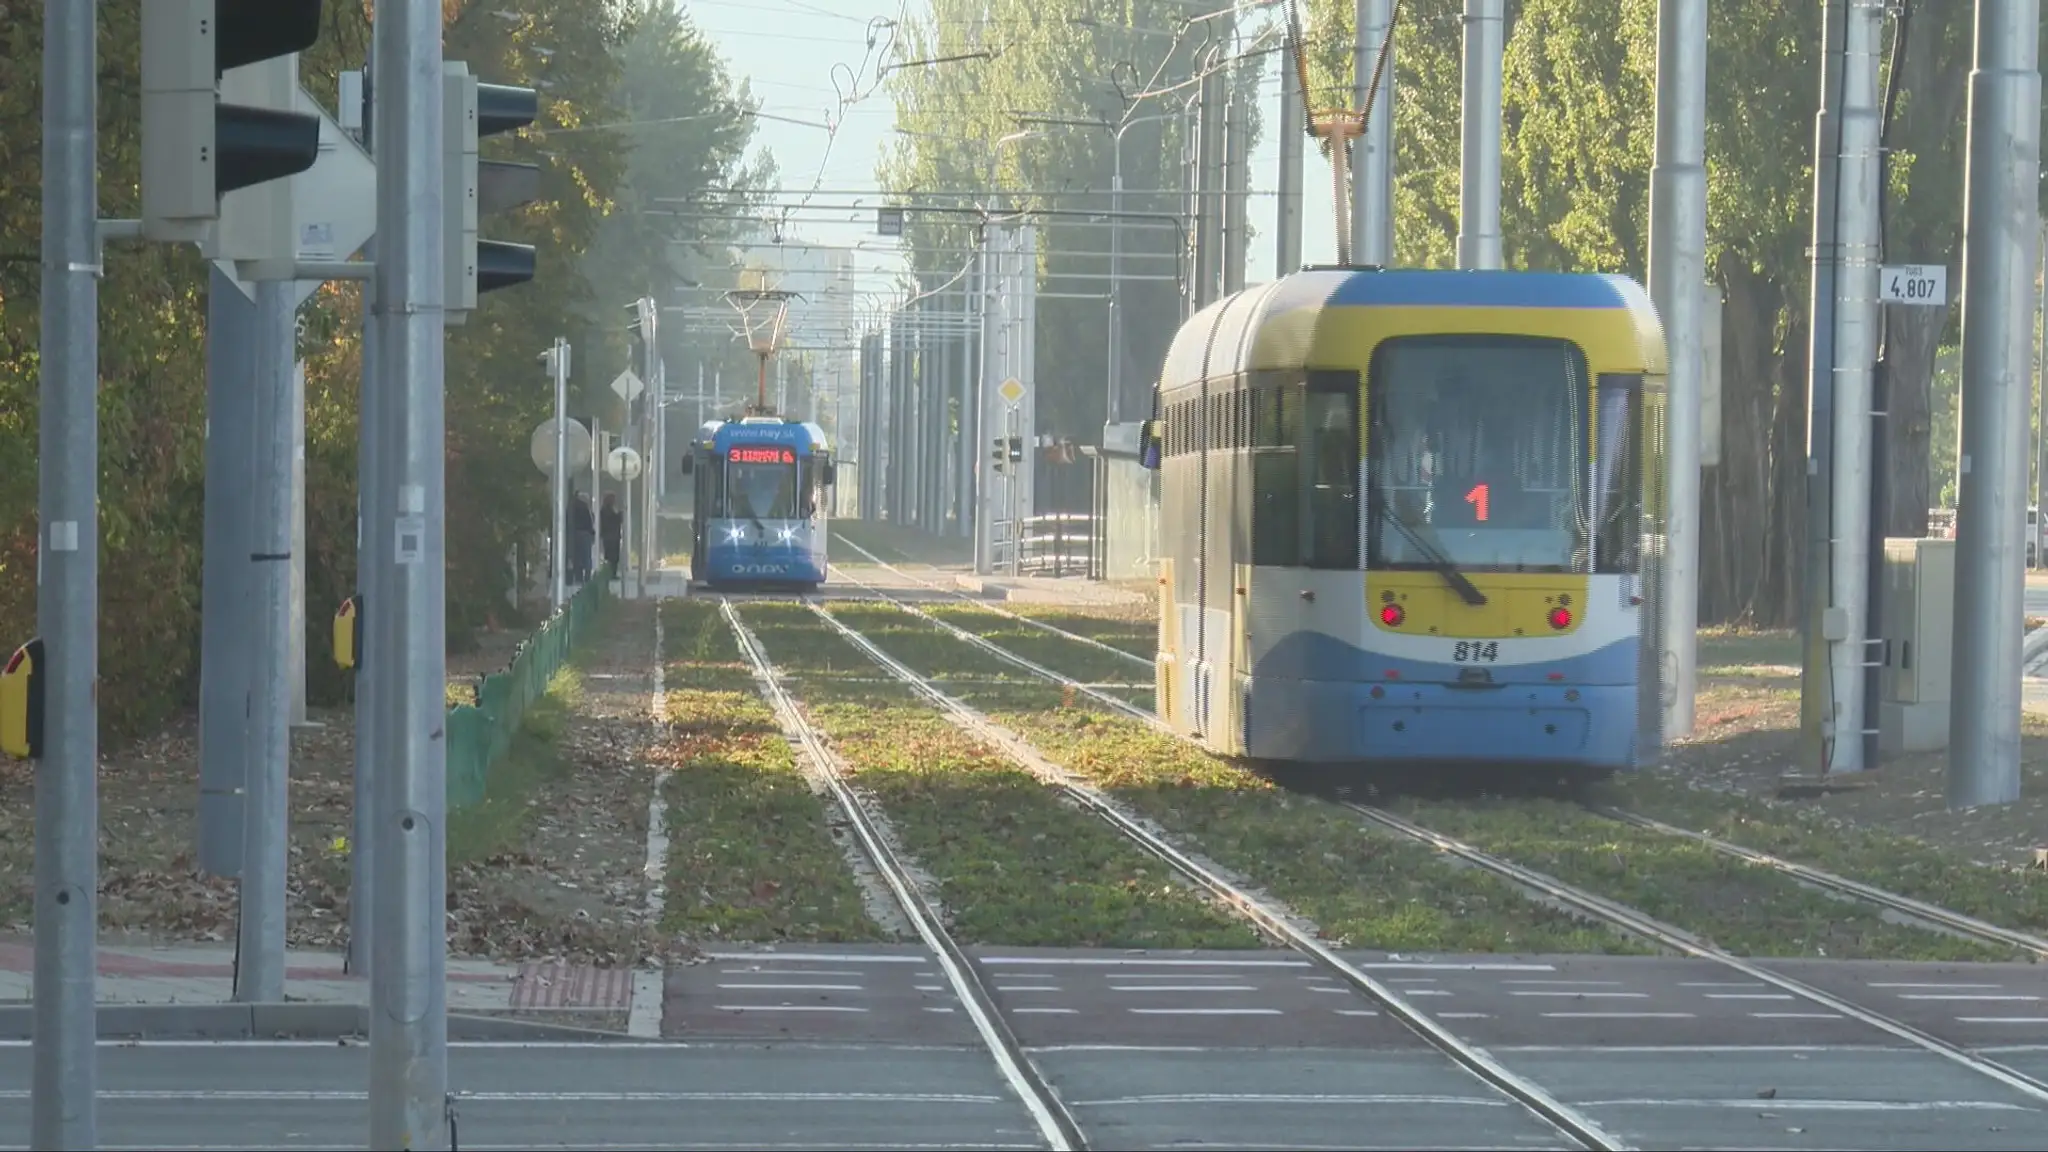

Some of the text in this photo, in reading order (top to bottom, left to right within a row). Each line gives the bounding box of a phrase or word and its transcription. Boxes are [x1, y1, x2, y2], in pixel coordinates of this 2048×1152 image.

[1891, 276, 1936, 298] 4.807
[730, 429, 795, 440] www.nay.sk
[729, 449, 741, 463] 3
[1464, 484, 1489, 521] 1
[1453, 641, 1499, 662] 814
